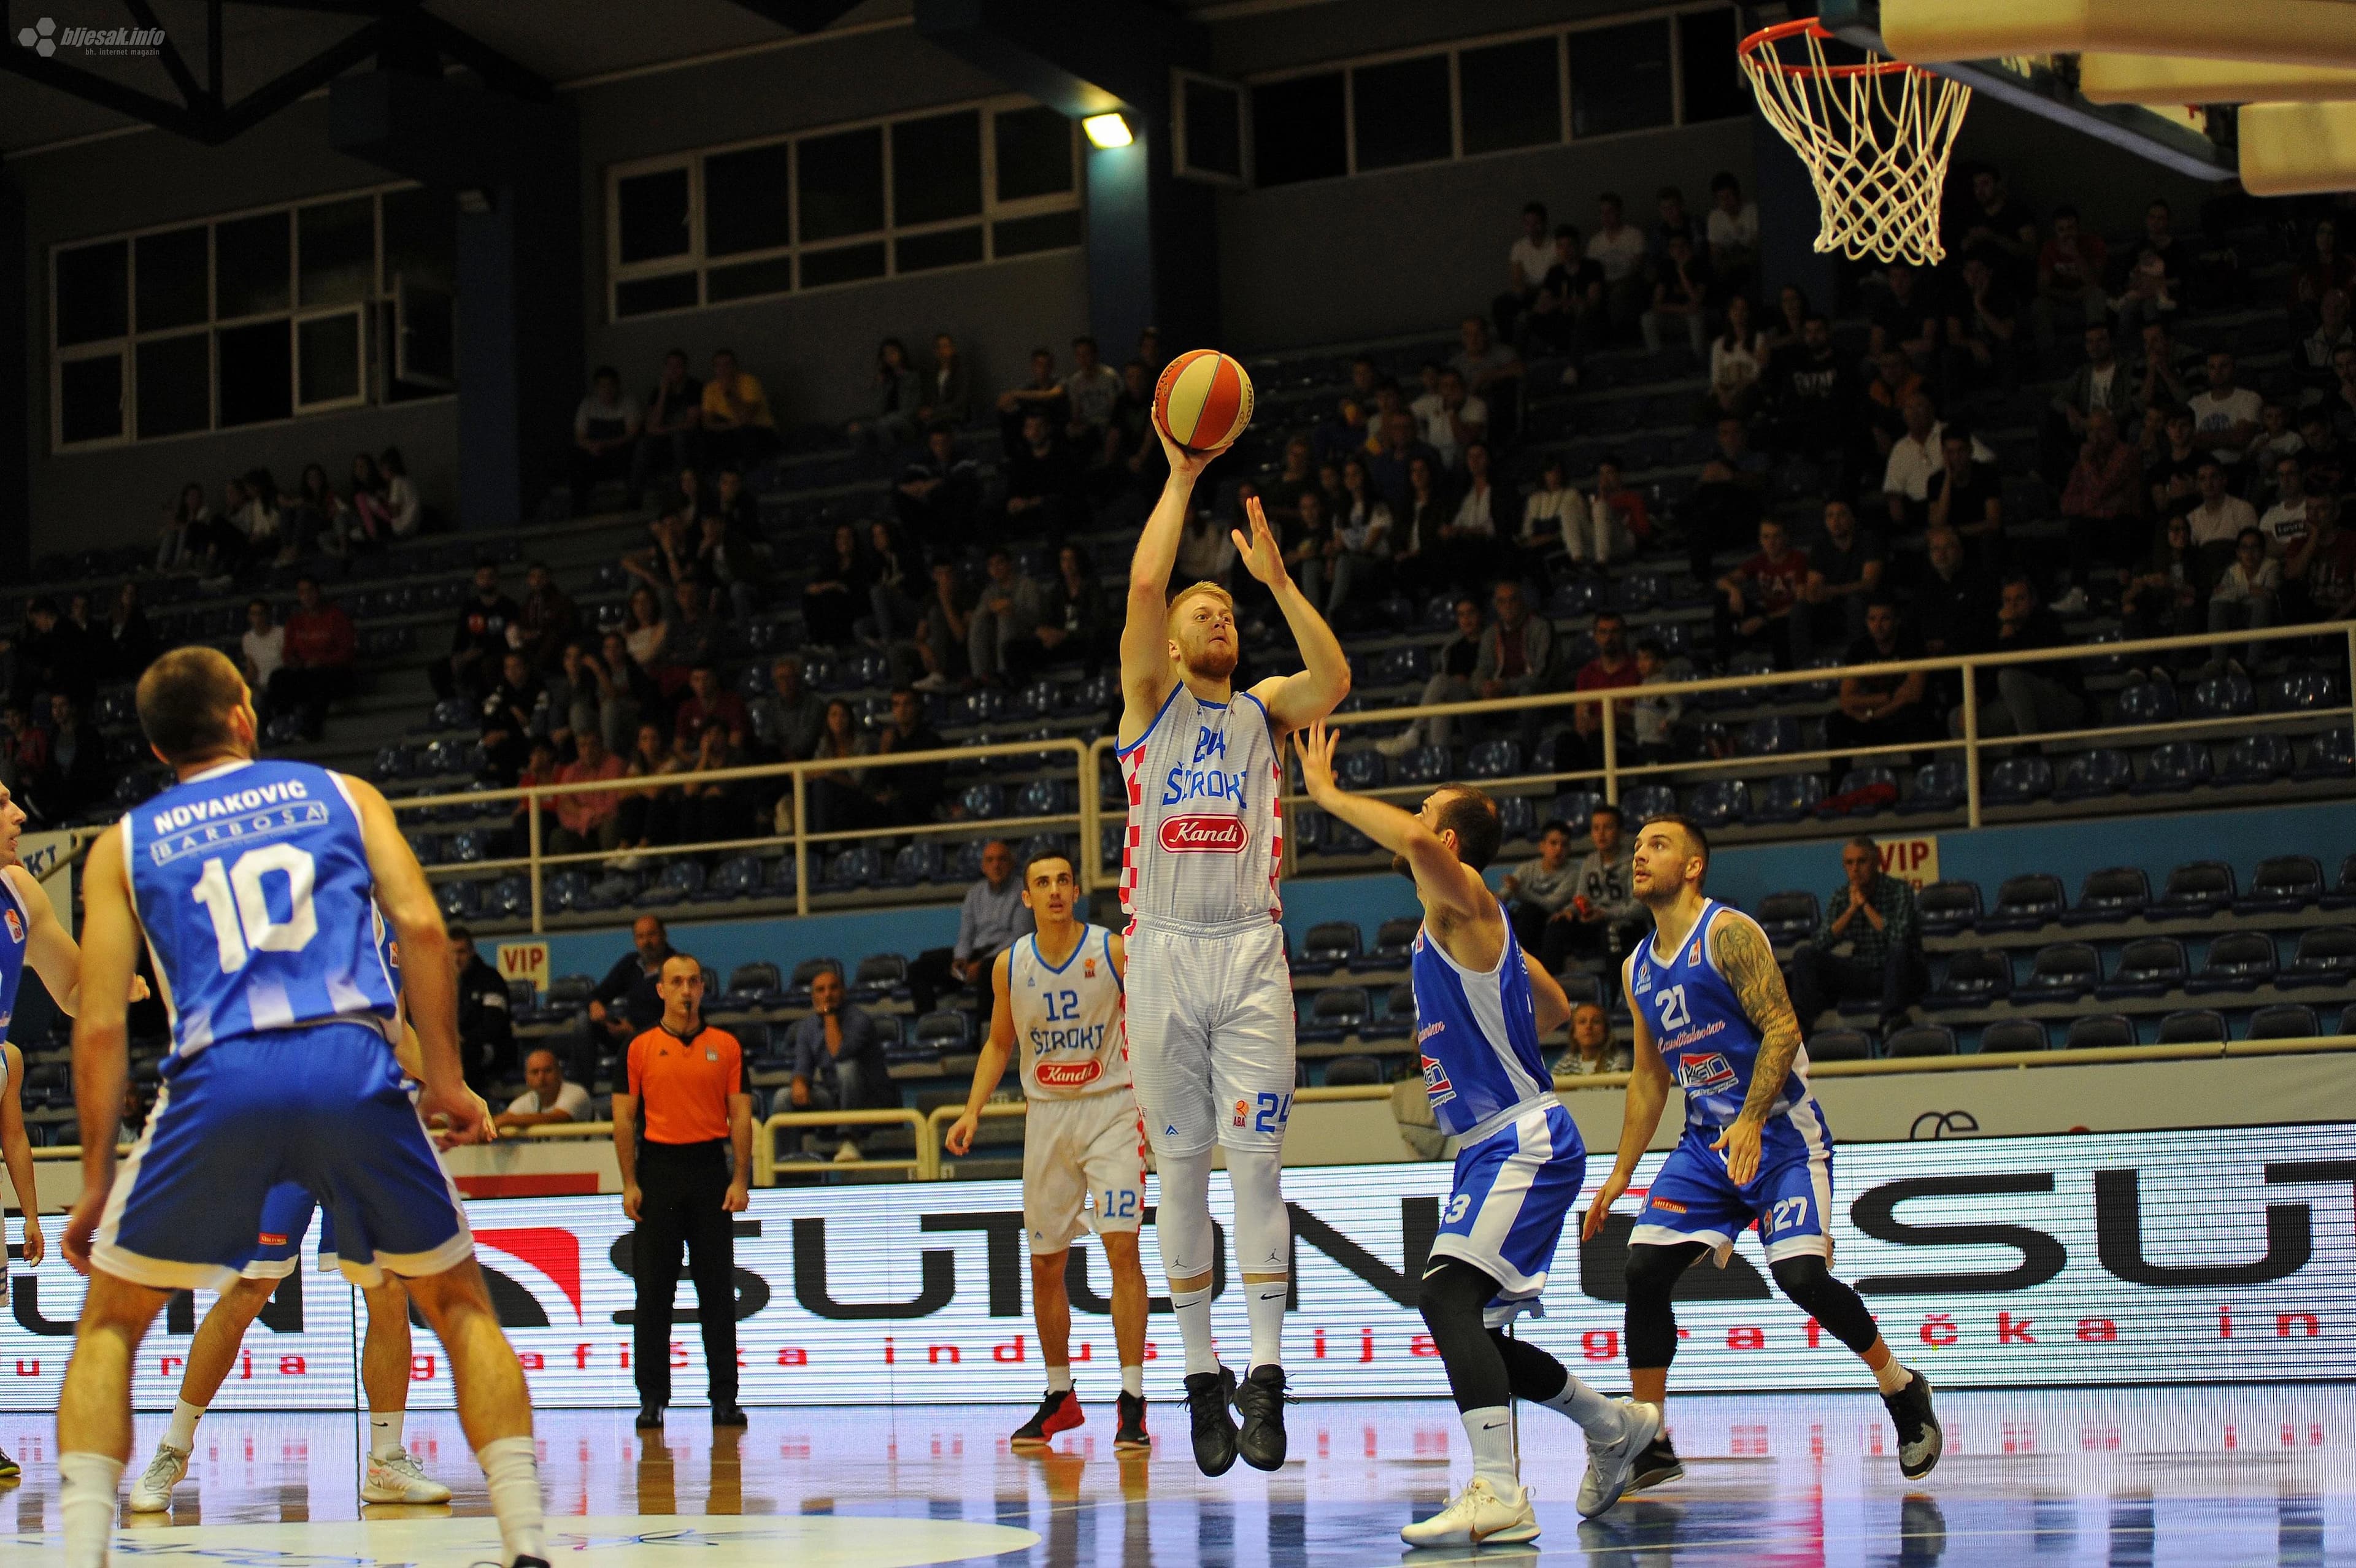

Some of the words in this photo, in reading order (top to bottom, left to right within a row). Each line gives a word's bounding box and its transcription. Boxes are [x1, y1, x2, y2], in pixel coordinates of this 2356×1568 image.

[158, 805, 323, 859] BARBOSA
[1168, 821, 1238, 843] Kandi
[1876, 841, 1929, 872] VIP
[192, 842, 319, 974] 10
[504, 948, 544, 973] VIP
[1043, 990, 1080, 1021] 12
[1233, 1116, 1245, 1128] ABA
[1255, 1092, 1293, 1133] 24
[1104, 1189, 1136, 1218] 12
[1773, 1196, 1807, 1232] 27
[1581, 1312, 2117, 1361] gafčka
